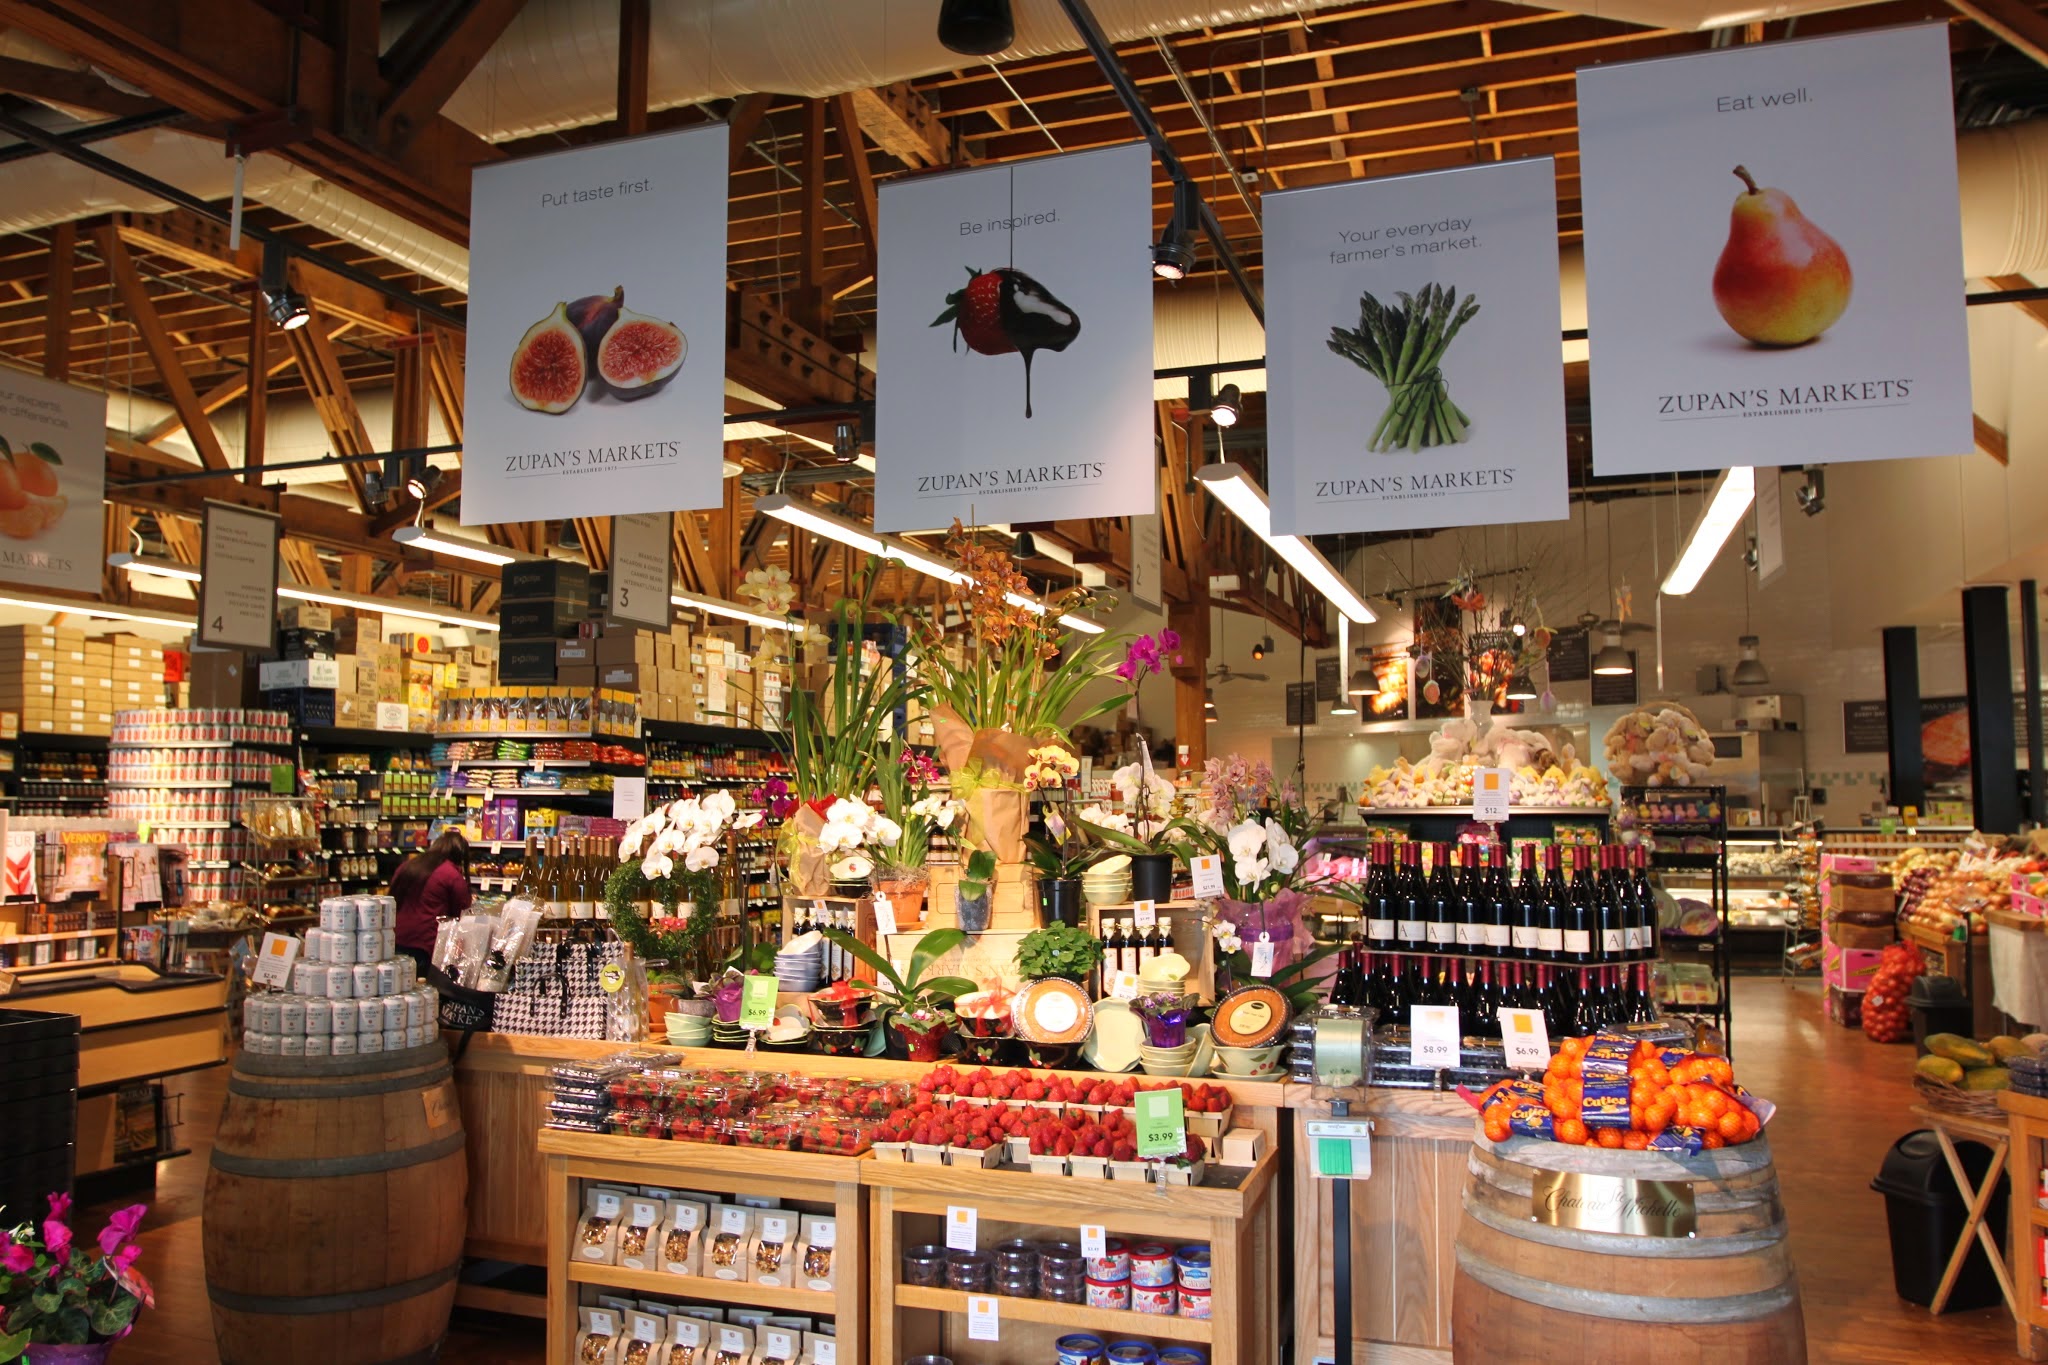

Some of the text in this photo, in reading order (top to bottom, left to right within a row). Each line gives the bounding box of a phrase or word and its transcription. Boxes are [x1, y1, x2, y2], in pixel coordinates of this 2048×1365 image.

[1717, 87, 1813, 113] Eat well.
[541, 178, 653, 208] Put taste first.
[960, 208, 1060, 236] Be inspired.
[1338, 217, 1472, 244] Your everyday
[1329, 235, 1483, 265] farmer's market.
[1658, 379, 1911, 415] ZUPAN'S MARKETS
[1743, 406, 1824, 418] ESTABLISHED 1975
[505, 440, 680, 473] ZUPAN'S MARKETS
[562, 465, 618, 476] ESTABLISHED 1975
[917, 461, 1104, 493] ZUPAN'S MARKETS
[978, 485, 1039, 496] ESTABLISHED 1975
[1315, 468, 1514, 498] ZUPAN'S MARKETS
[1381, 490, 1446, 501] ESTABLISHED 1975
[3, 551, 73, 572] MARKETS
[1136, 563, 1142, 586] 2
[620, 587, 629, 608] 3
[211, 615, 224, 633] 4
[61, 831, 109, 844] VERANDA
[1457, 926, 1468, 941] A
[1608, 933, 1621, 948] A
[1628, 931, 1641, 946] A
[748, 1009, 767, 1017] $6.99
[1423, 1045, 1448, 1054] $8.99
[1515, 1047, 1540, 1056] $6.99
[1583, 1096, 1628, 1108] Cuties
[1511, 1108, 1551, 1119] Cuties
[1148, 1132, 1174, 1142] $3.99
[1175, 1126, 1188, 1154] SALE
